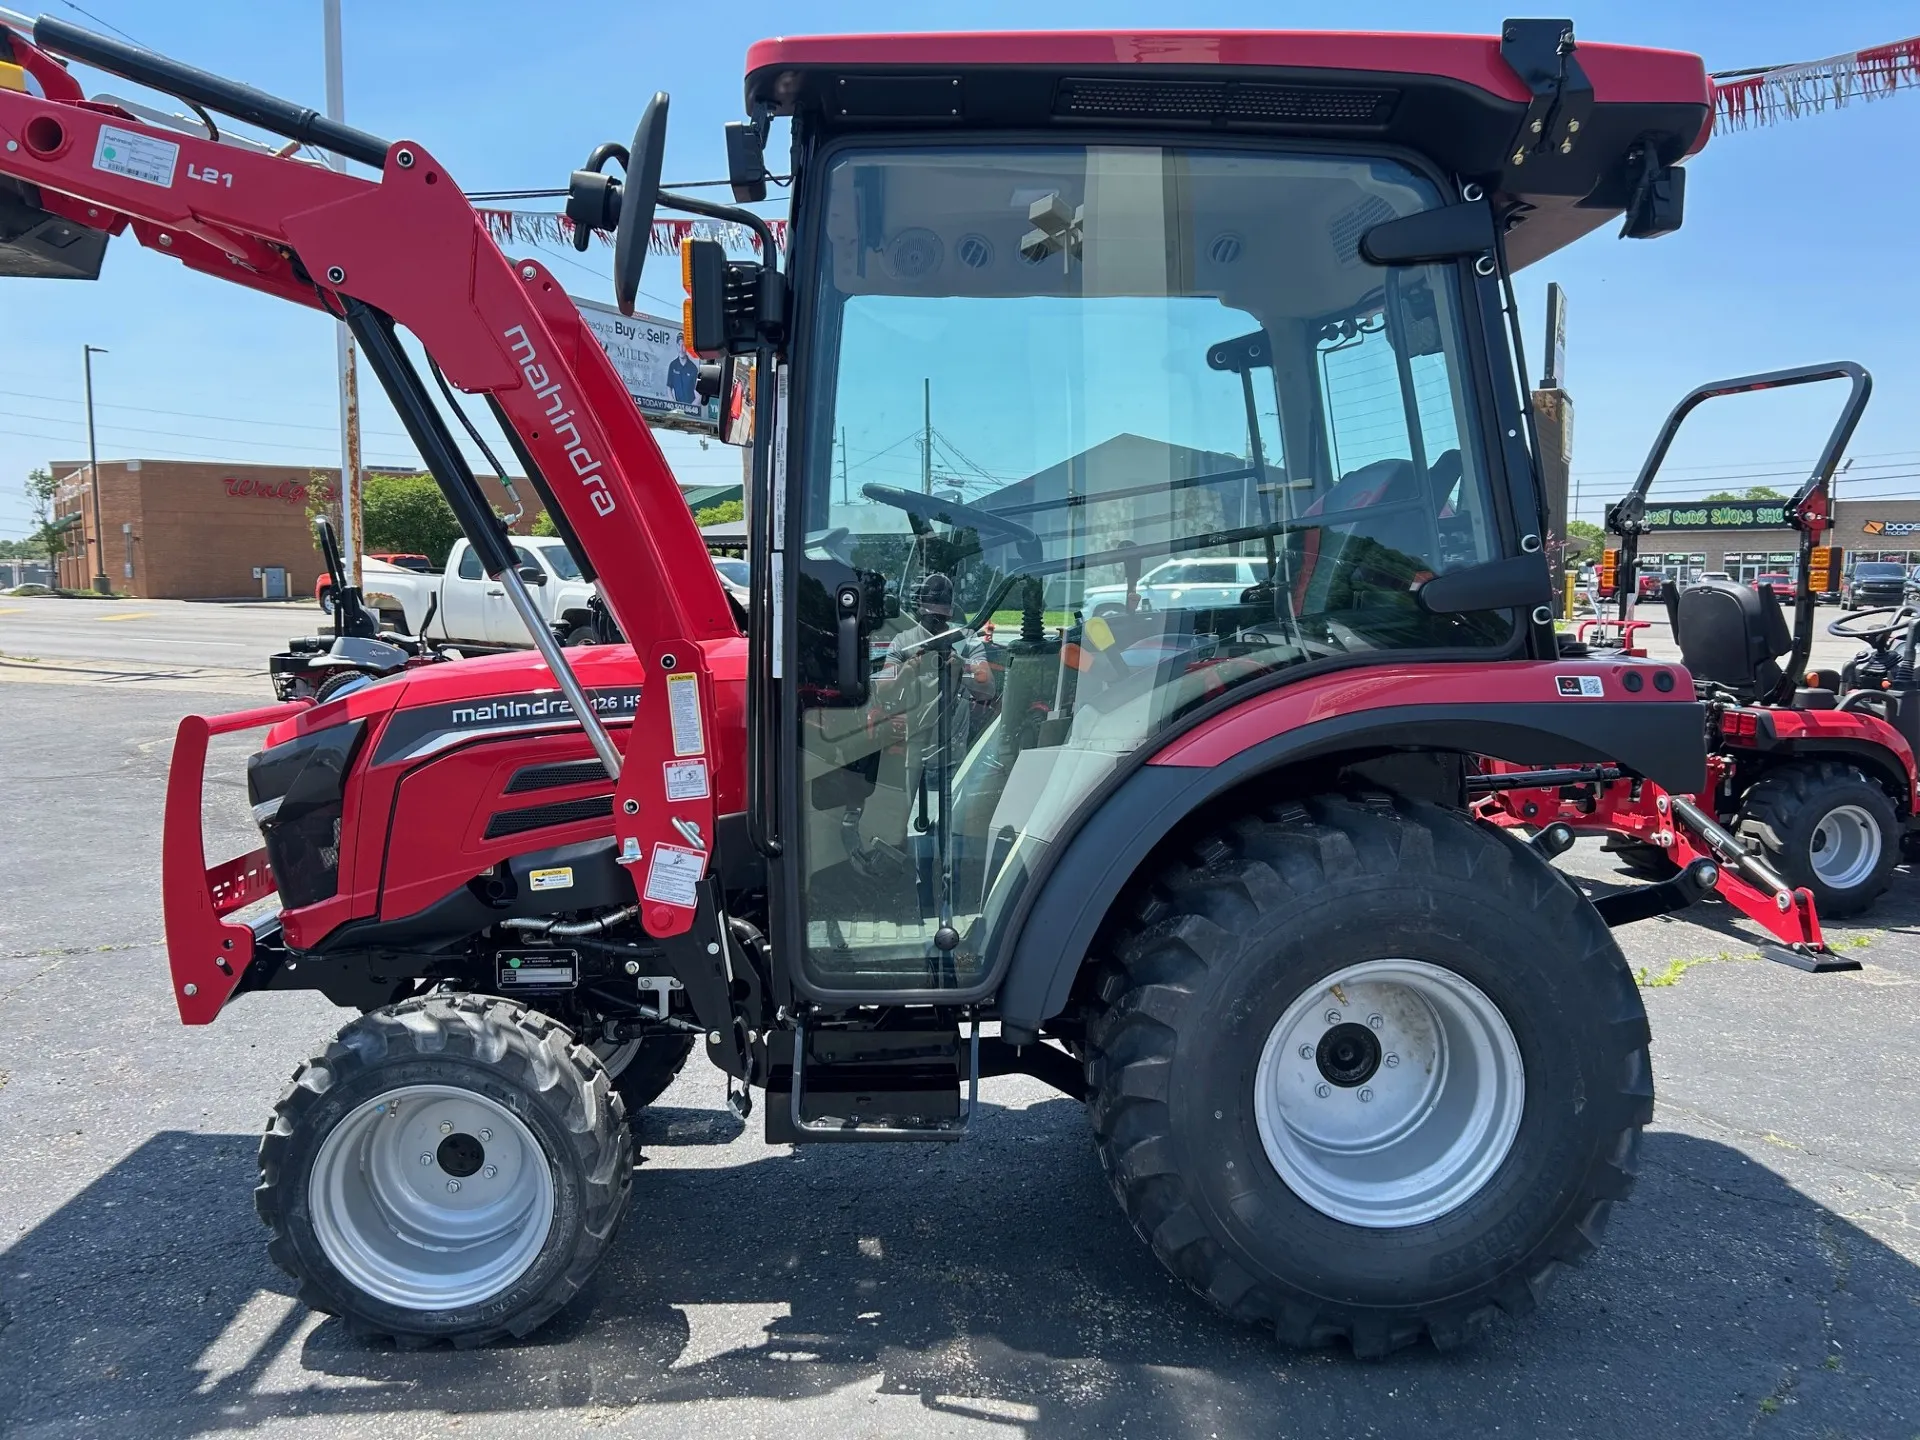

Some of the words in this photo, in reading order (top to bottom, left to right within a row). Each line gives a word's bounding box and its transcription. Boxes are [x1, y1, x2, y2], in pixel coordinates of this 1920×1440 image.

[187, 163, 233, 188] L21
[605, 324, 614, 334] to
[615, 321, 636, 340] Buy
[637, 332, 646, 340] or
[646, 328, 670, 346] Sell?
[617, 346, 650, 363] MILLS
[503, 324, 616, 517] mahindra
[1756, 507, 1785, 525] SHO
[1885, 521, 1920, 531] boos
[1641, 555, 1661, 564] OPEN
[452, 697, 573, 723] mahindra
[589, 696, 618, 711] 126
